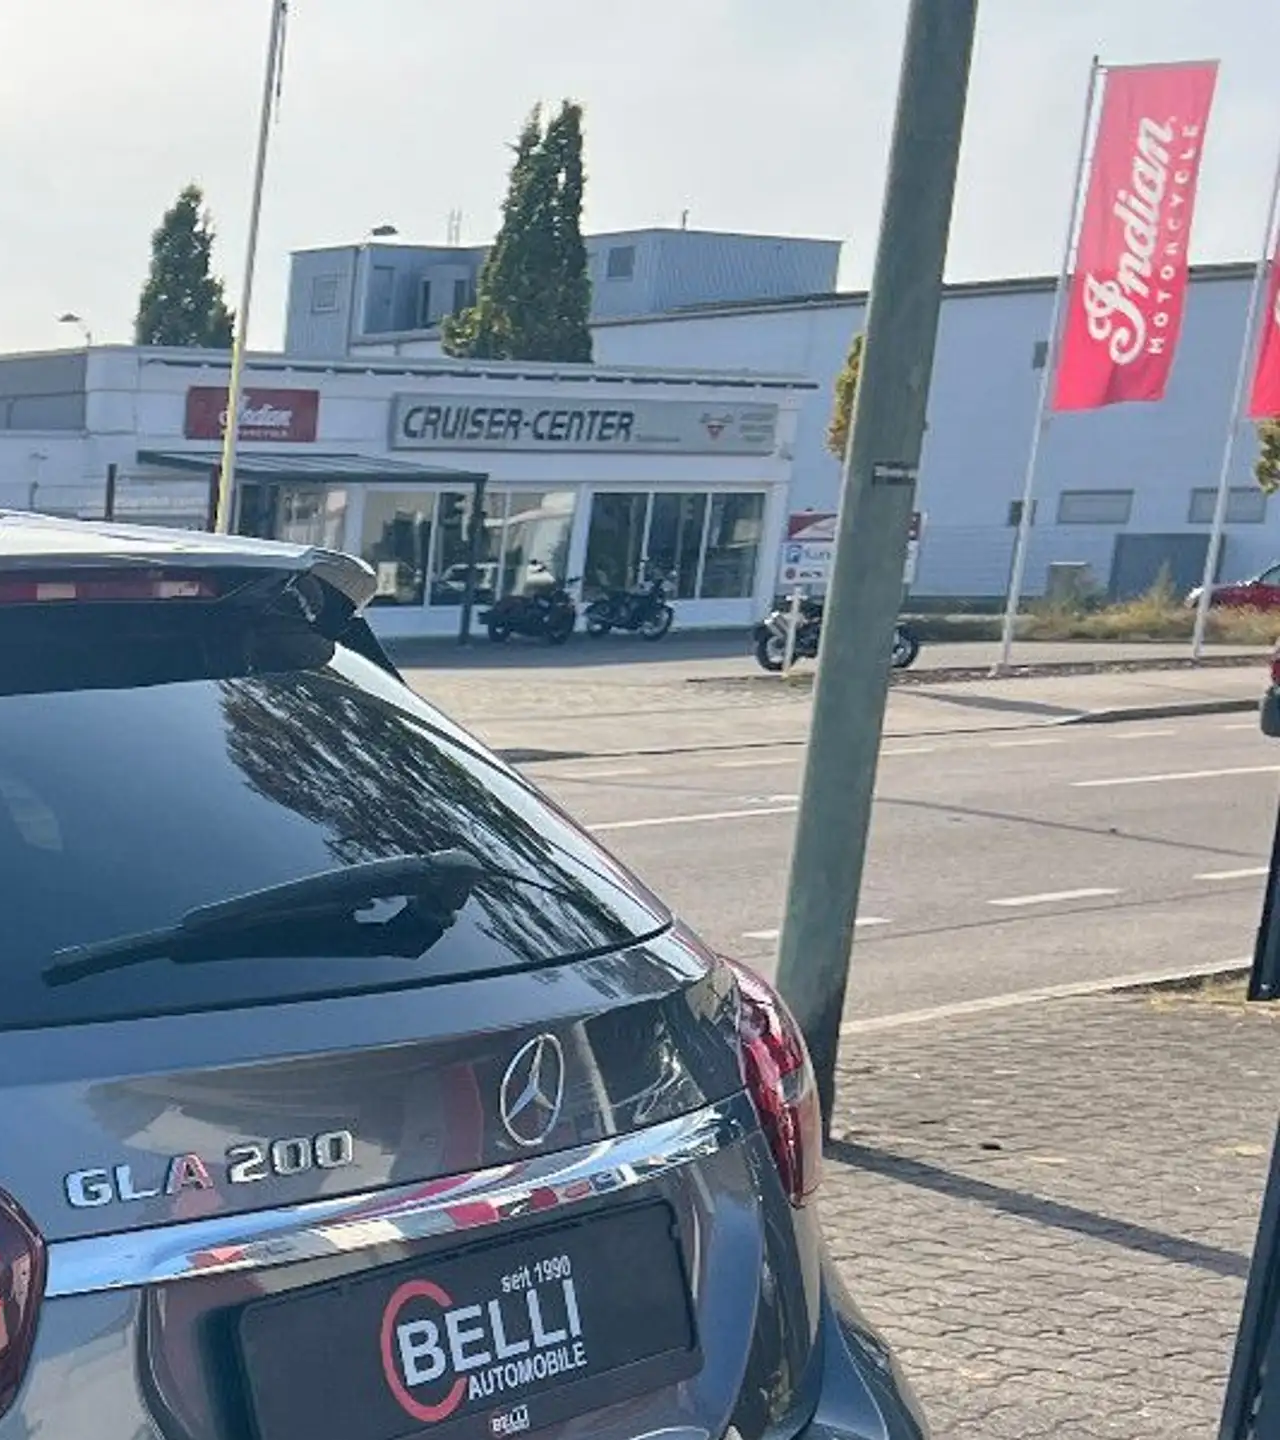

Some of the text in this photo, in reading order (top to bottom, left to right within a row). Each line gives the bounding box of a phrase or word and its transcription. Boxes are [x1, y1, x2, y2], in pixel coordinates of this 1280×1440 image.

[1084, 117, 1176, 365] Indian
[1146, 123, 1200, 355] MOTORCYCLE
[403, 404, 635, 442] CRUISER-CENTER
[64, 1129, 355, 1209] GLA 200
[501, 1255, 572, 1293] seit 1990
[397, 1279, 582, 1387] BELLI
[468, 1342, 589, 1400] AUTOMOBILE
